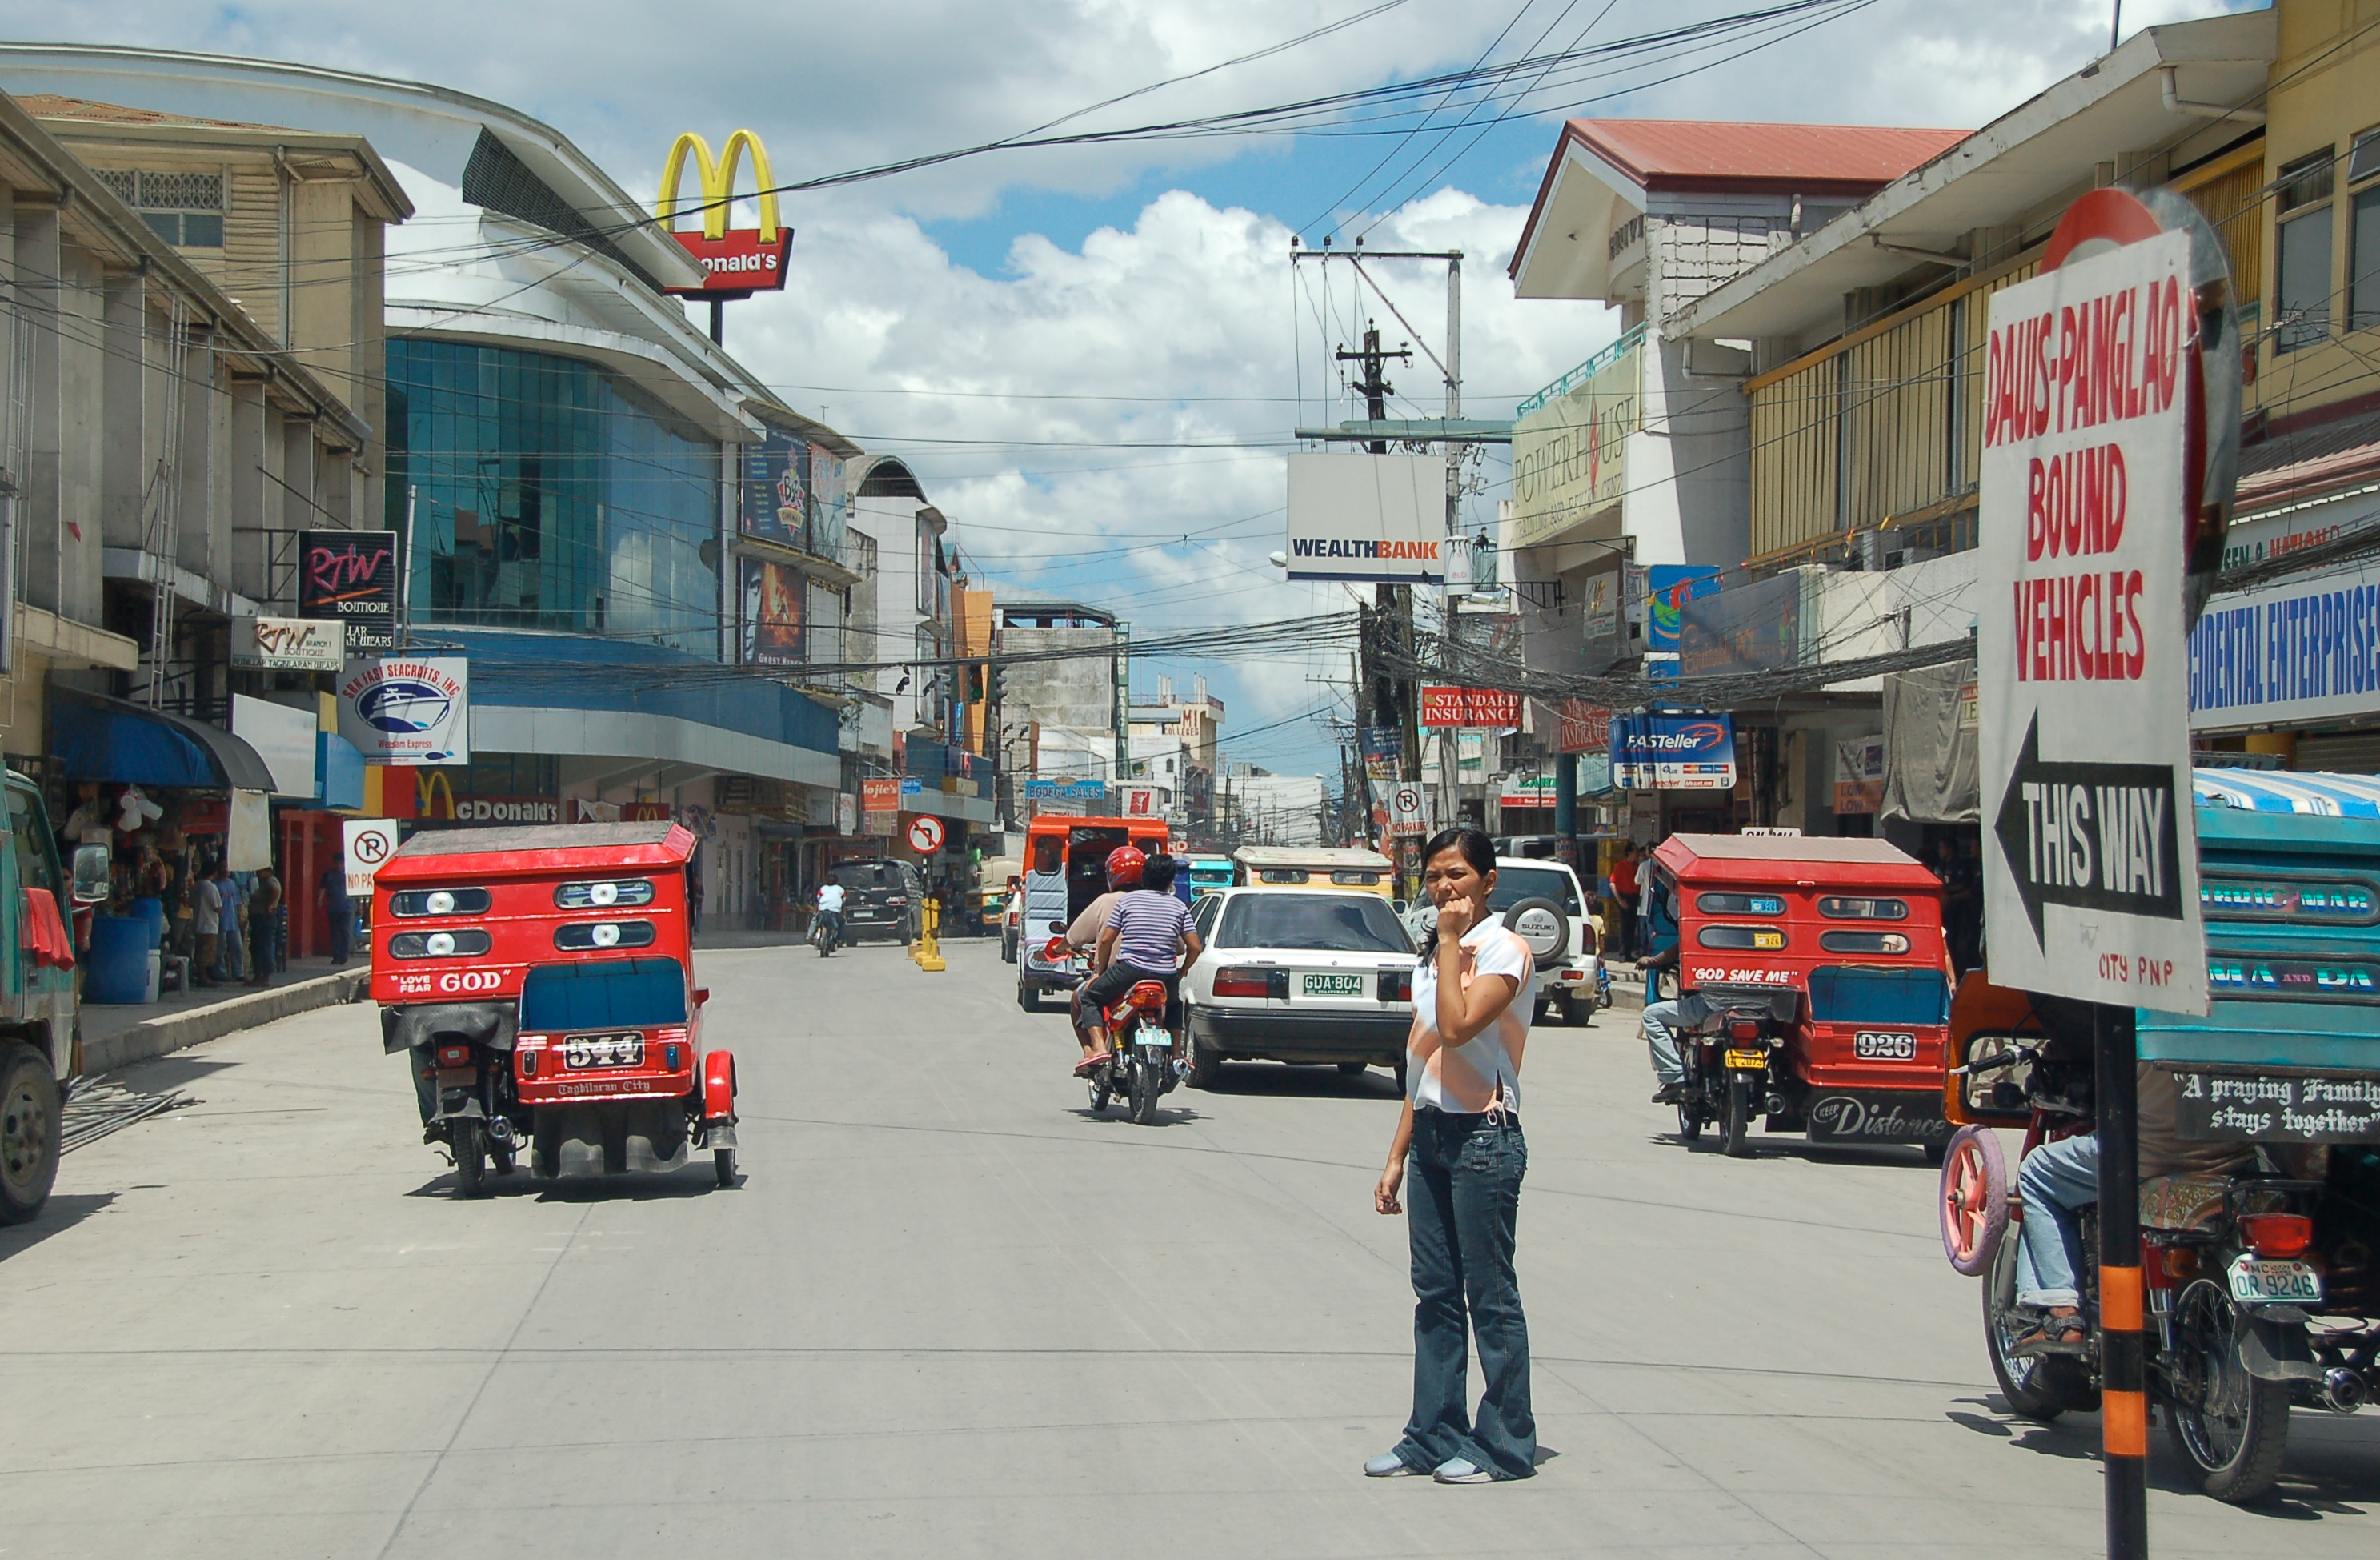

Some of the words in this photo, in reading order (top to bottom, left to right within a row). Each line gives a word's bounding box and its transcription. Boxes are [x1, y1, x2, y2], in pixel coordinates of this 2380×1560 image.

[701, 253, 777, 272] onald's
[1985, 275, 2179, 448] DAUIS-PANGLAO
[2027, 443, 2126, 562] BOUND
[1292, 539, 1438, 559] WEALTHBANK
[305, 543, 391, 597] RTW
[337, 602, 390, 613] BOUTIQUE
[2013, 569, 2145, 682] VEHICLES
[284, 648, 325, 657] BOUTIQUE
[2187, 605, 2263, 712] CIDENTAL
[362, 666, 384, 683] FAST
[1436, 694, 1519, 707] STANDARD
[1425, 708, 1519, 720] INSURANCE
[407, 739, 433, 749] Express
[1626, 734, 1701, 748] FASTeller
[1029, 787, 1067, 799] BODEGA
[1070, 786, 1100, 799] SALES
[1392, 823, 1400, 832] NO
[1401, 820, 1427, 833] PARKING
[1168, 840, 1188, 852] RD
[2022, 782, 2093, 887] THIS
[2096, 786, 2164, 896] WAY
[347, 873, 359, 889] NO
[361, 873, 374, 888] PA
[1691, 968, 1725, 980] "GOD
[1729, 969, 1764, 982] SAVE
[1765, 971, 1798, 983] ME"
[2098, 953, 2128, 983] CITY
[2138, 956, 2173, 986] PNP
[2209, 963, 2280, 988] MA
[2282, 973, 2310, 982] AND
[400, 985, 431, 993] FEAR
[569, 1035, 639, 1067] 544
[1858, 1034, 1913, 1058] 926
[558, 1081, 617, 1096] Tagbilaran
[623, 1080, 651, 1092] City
[2210, 1077, 2292, 1106] praying
[2302, 1079, 2380, 1109] Family
[1814, 1097, 1946, 1137] Distance
[1818, 1103, 1839, 1118] KEEP
[2210, 1105, 2271, 1135] stays
[2282, 1107, 2380, 1138] together"
[2251, 1265, 2270, 1273] MC
[2235, 1275, 2260, 1297] OR
[2266, 1274, 2315, 1297] 9246
